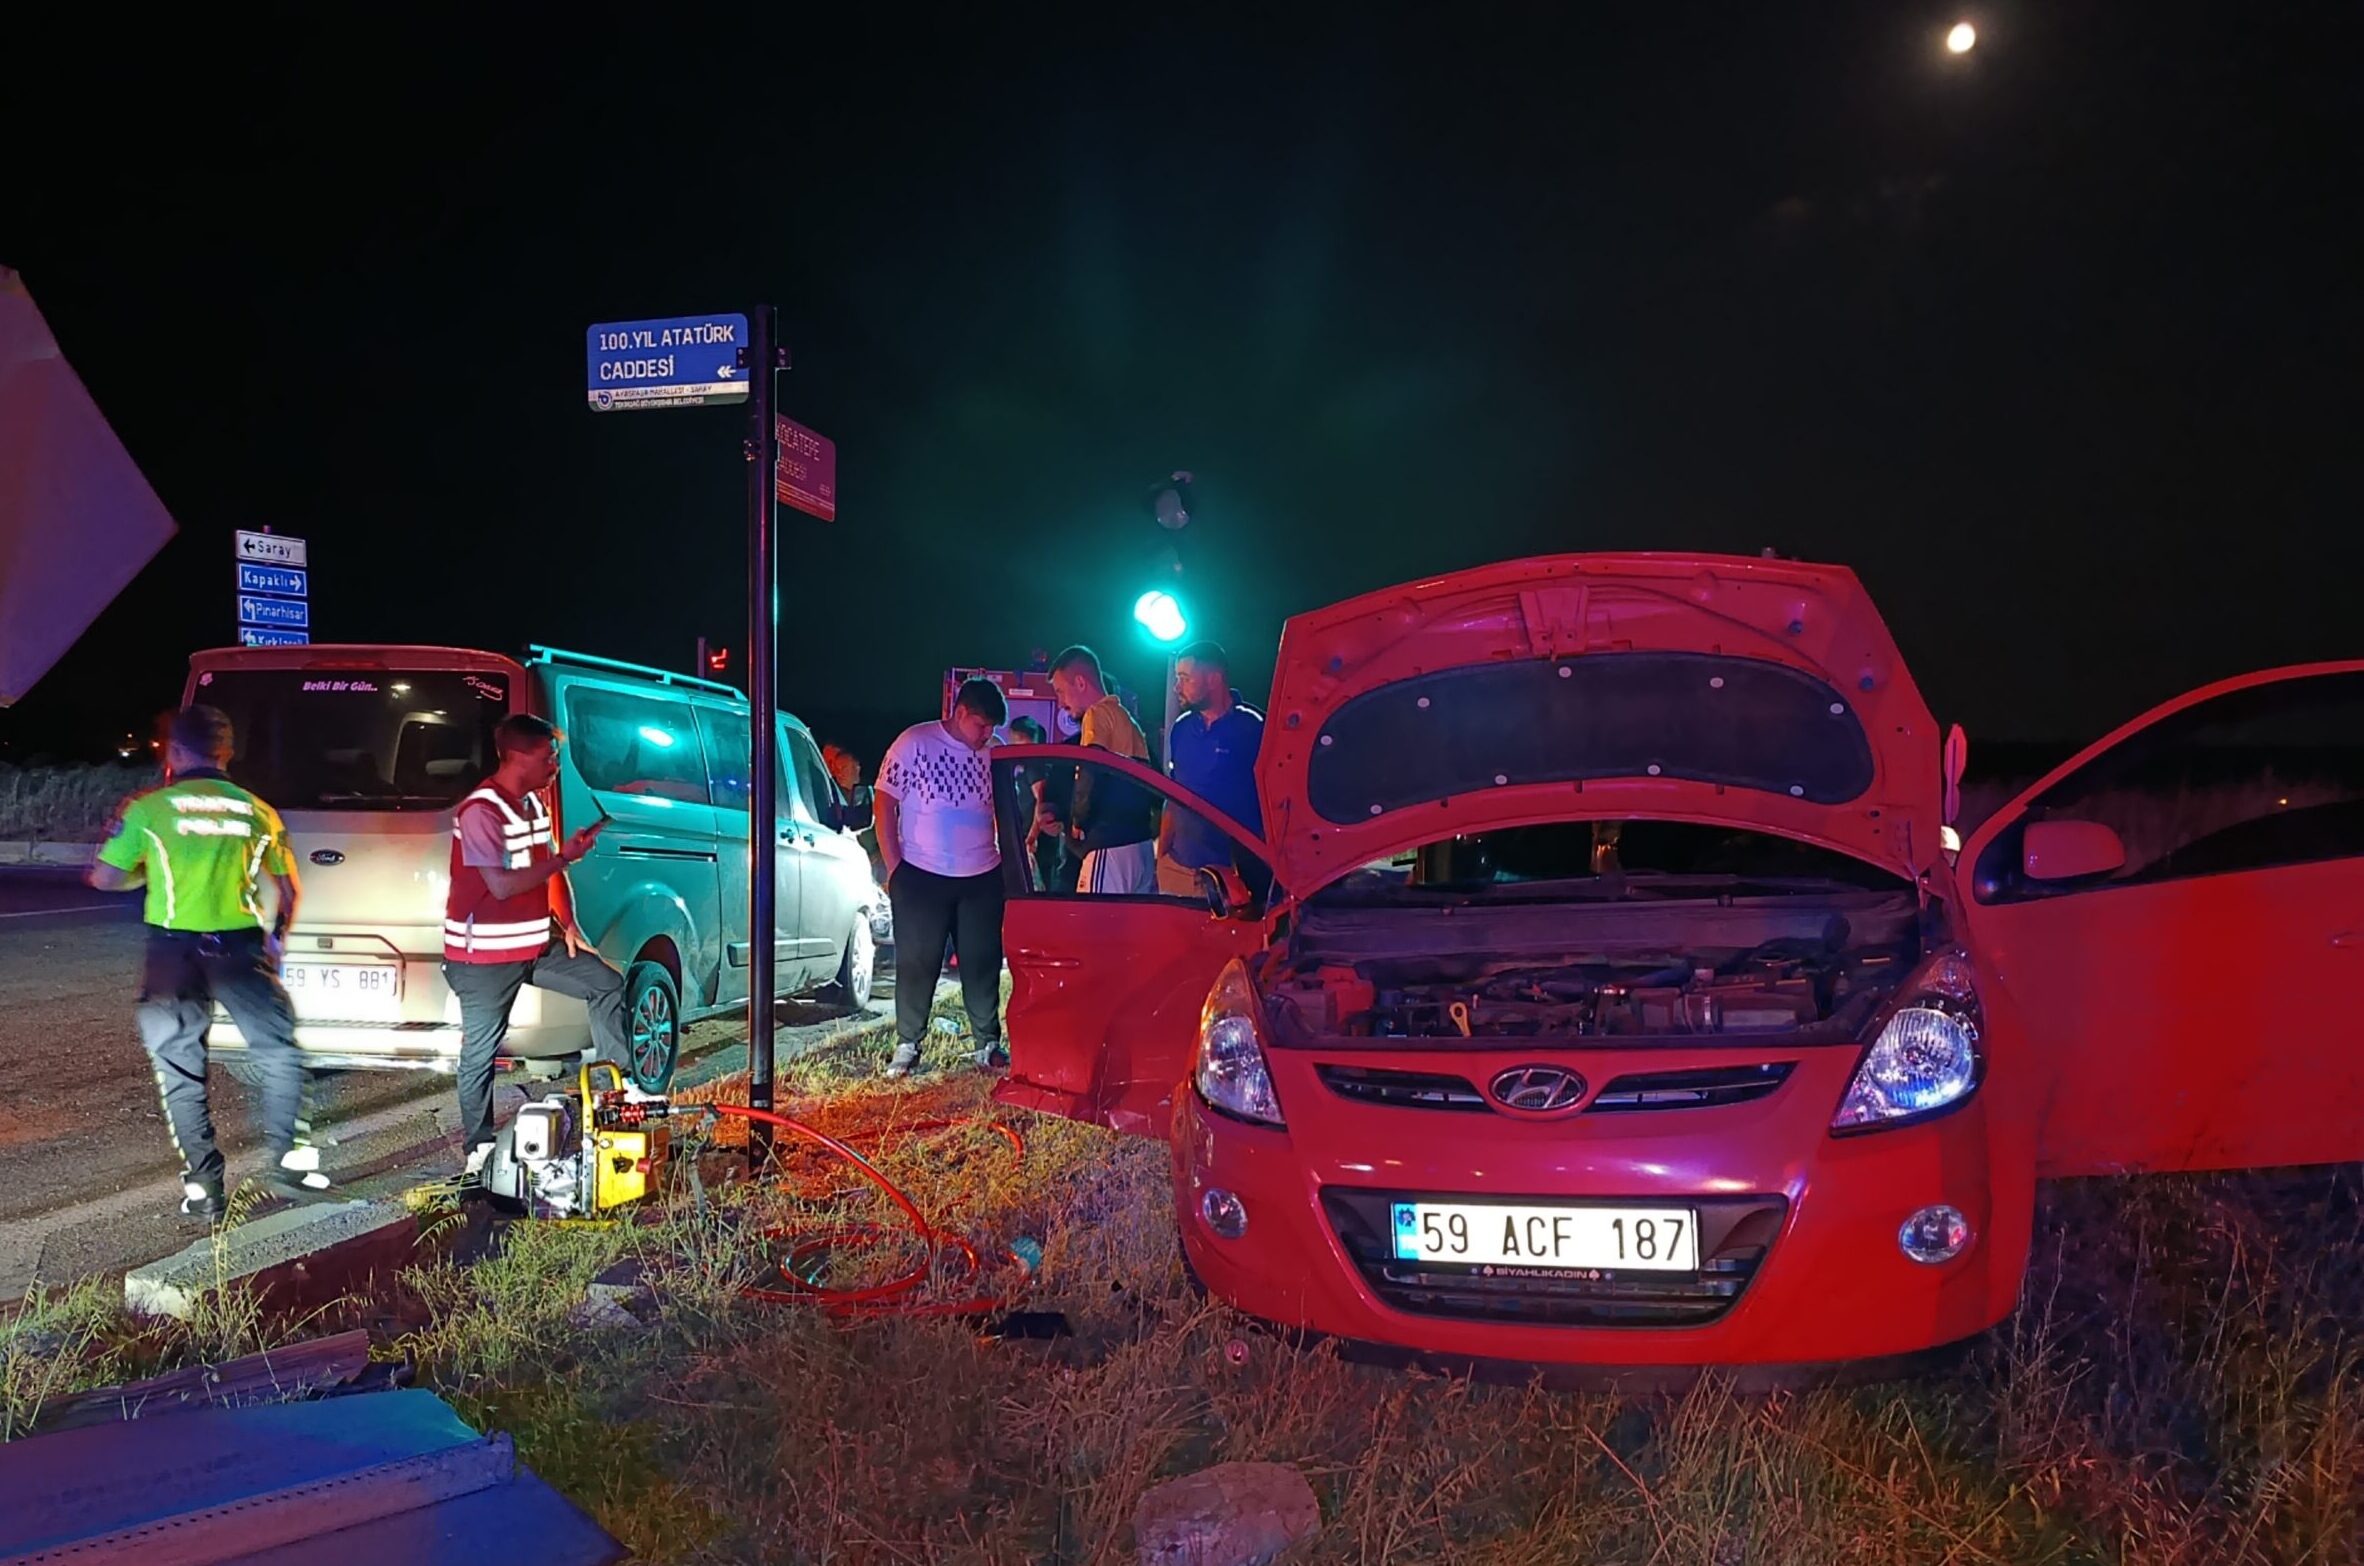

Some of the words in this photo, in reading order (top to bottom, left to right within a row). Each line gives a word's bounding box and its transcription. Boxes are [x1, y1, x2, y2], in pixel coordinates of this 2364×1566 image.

[600, 330, 657, 351] 100.YIL
[661, 323, 734, 347] ATATÜRK
[600, 354, 675, 380] CADDESİ
[258, 540, 291, 559] Saray
[244, 570, 288, 588] Kapaklı
[302, 680, 332, 692] Belki
[331, 680, 349, 692] Bir
[285, 967, 306, 988] 59
[320, 969, 341, 989] YS
[359, 970, 389, 990] 881
[1422, 1211, 1469, 1254] 59
[1502, 1214, 1573, 1258] ACF
[1612, 1217, 1685, 1262] 187
